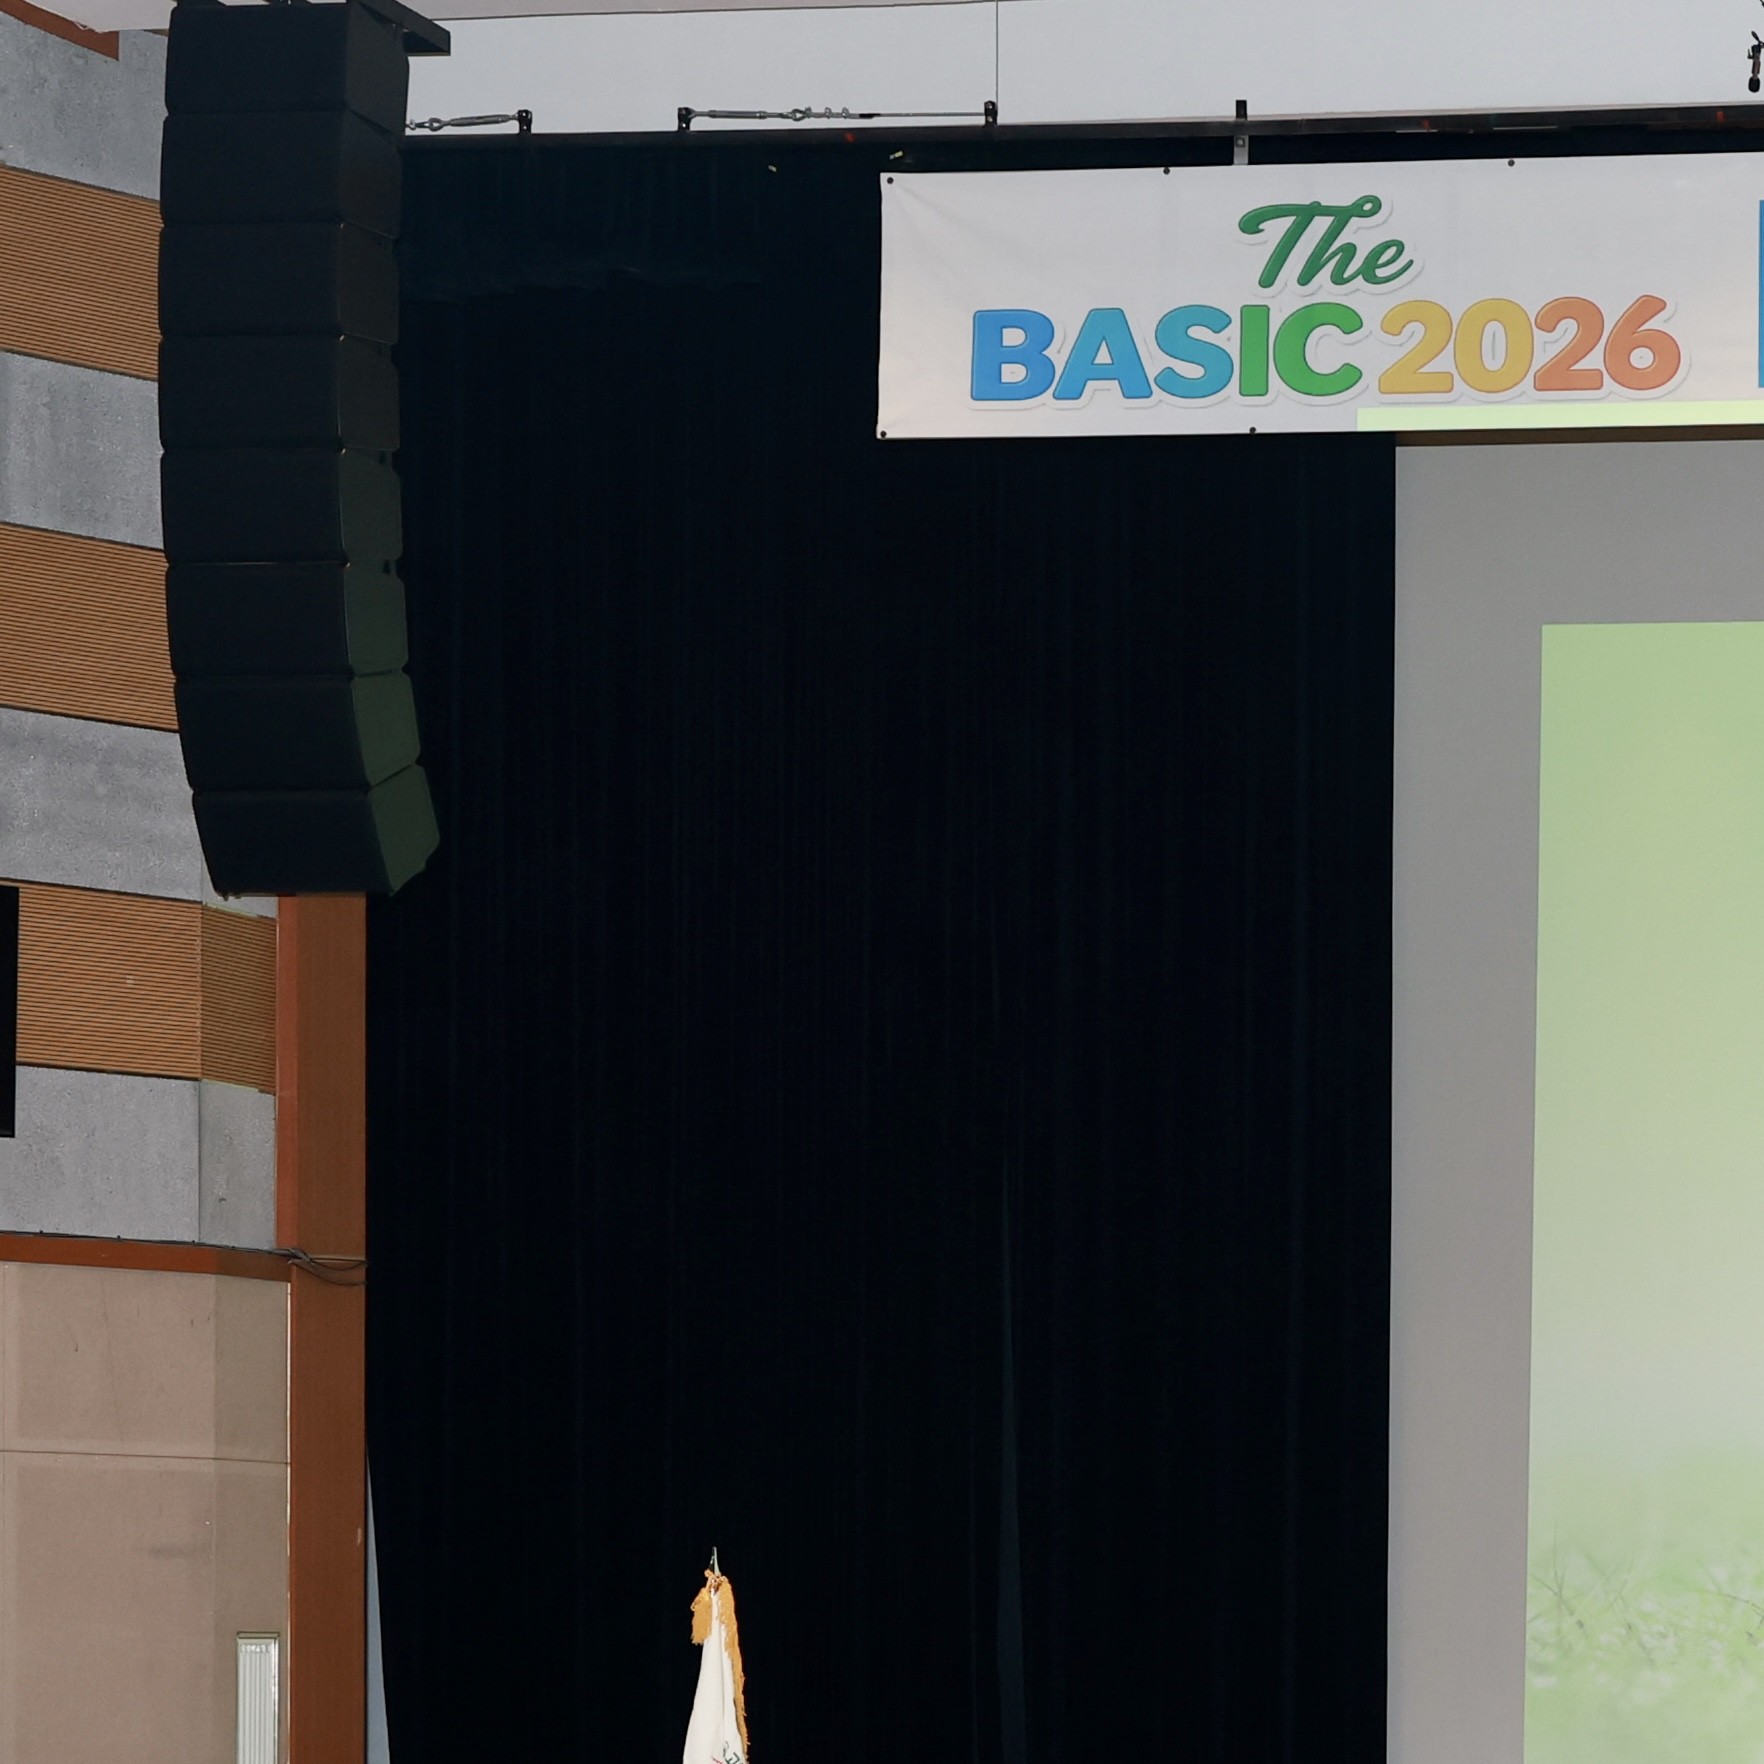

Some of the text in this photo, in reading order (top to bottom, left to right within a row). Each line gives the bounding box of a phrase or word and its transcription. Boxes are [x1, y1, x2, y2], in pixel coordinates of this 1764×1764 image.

[1238, 195, 1413, 288] The
[971, 295, 1682, 401] BASIC 2026
